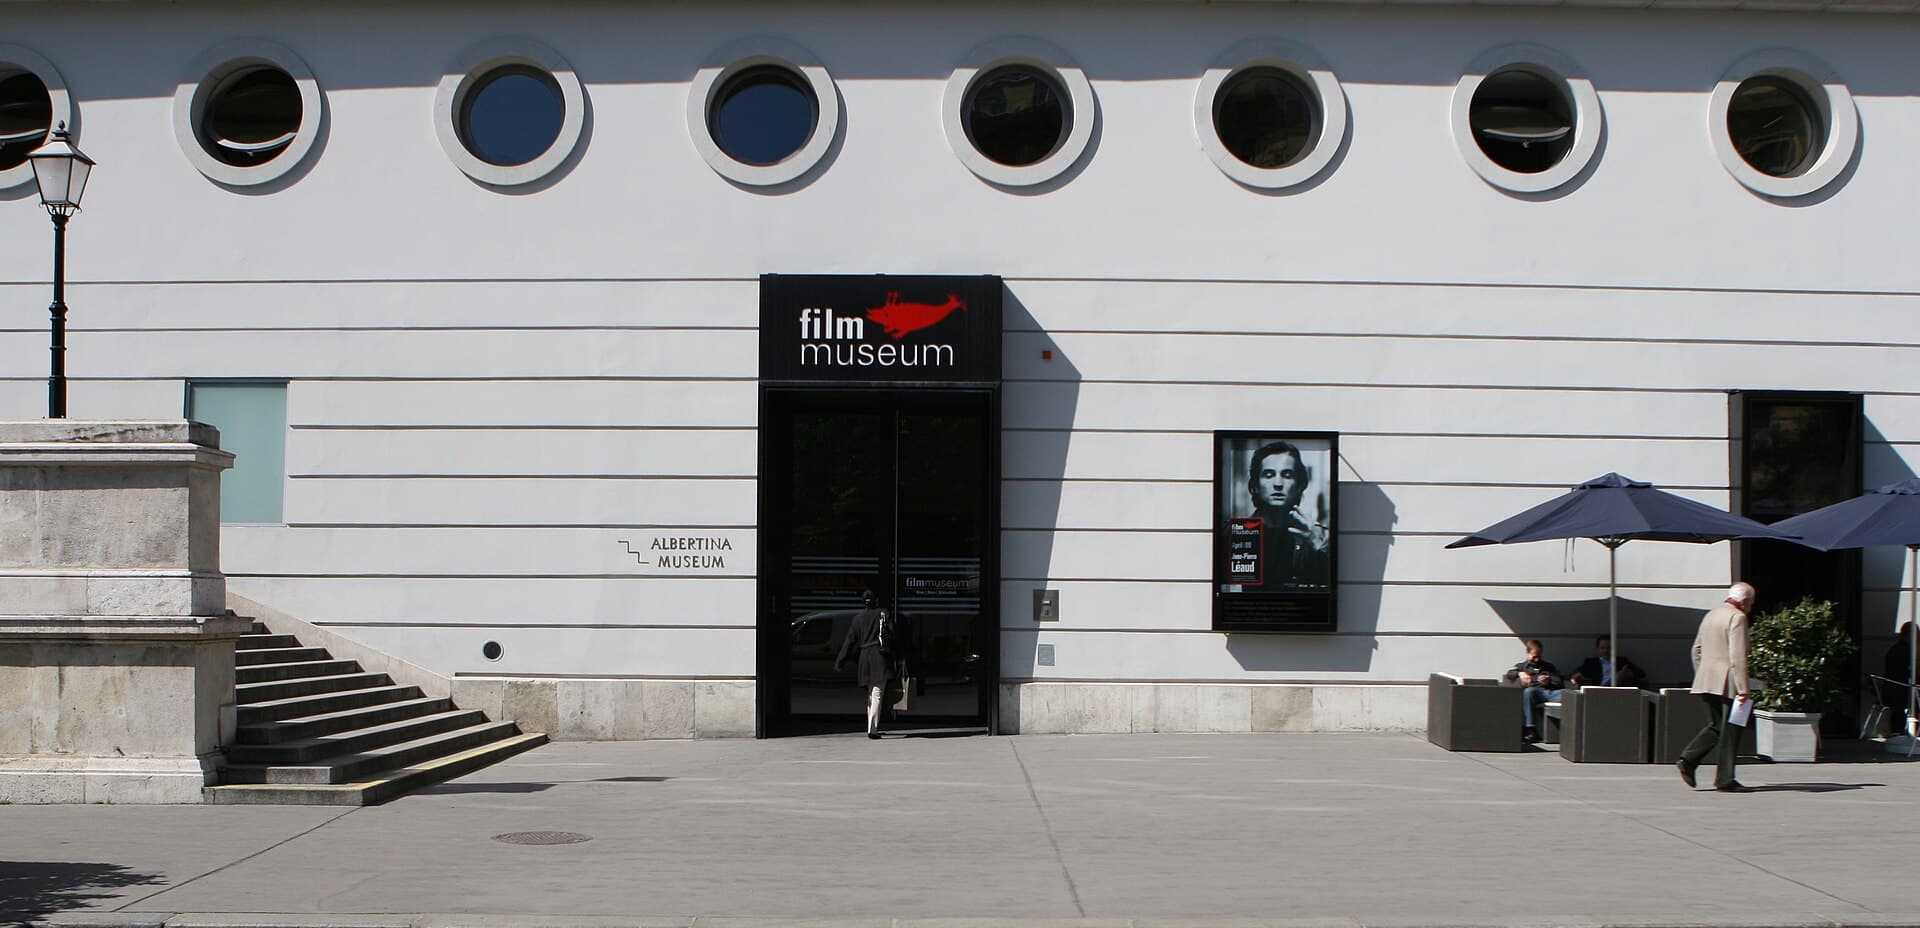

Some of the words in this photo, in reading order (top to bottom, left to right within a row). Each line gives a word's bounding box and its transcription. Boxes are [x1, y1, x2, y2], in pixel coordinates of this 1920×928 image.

[800, 308, 864, 340] film
[801, 343, 954, 366] museum
[651, 537, 732, 551] ALBERTINA
[658, 555, 725, 569] MUSEUM
[1231, 561, 1255, 573] Léaud
